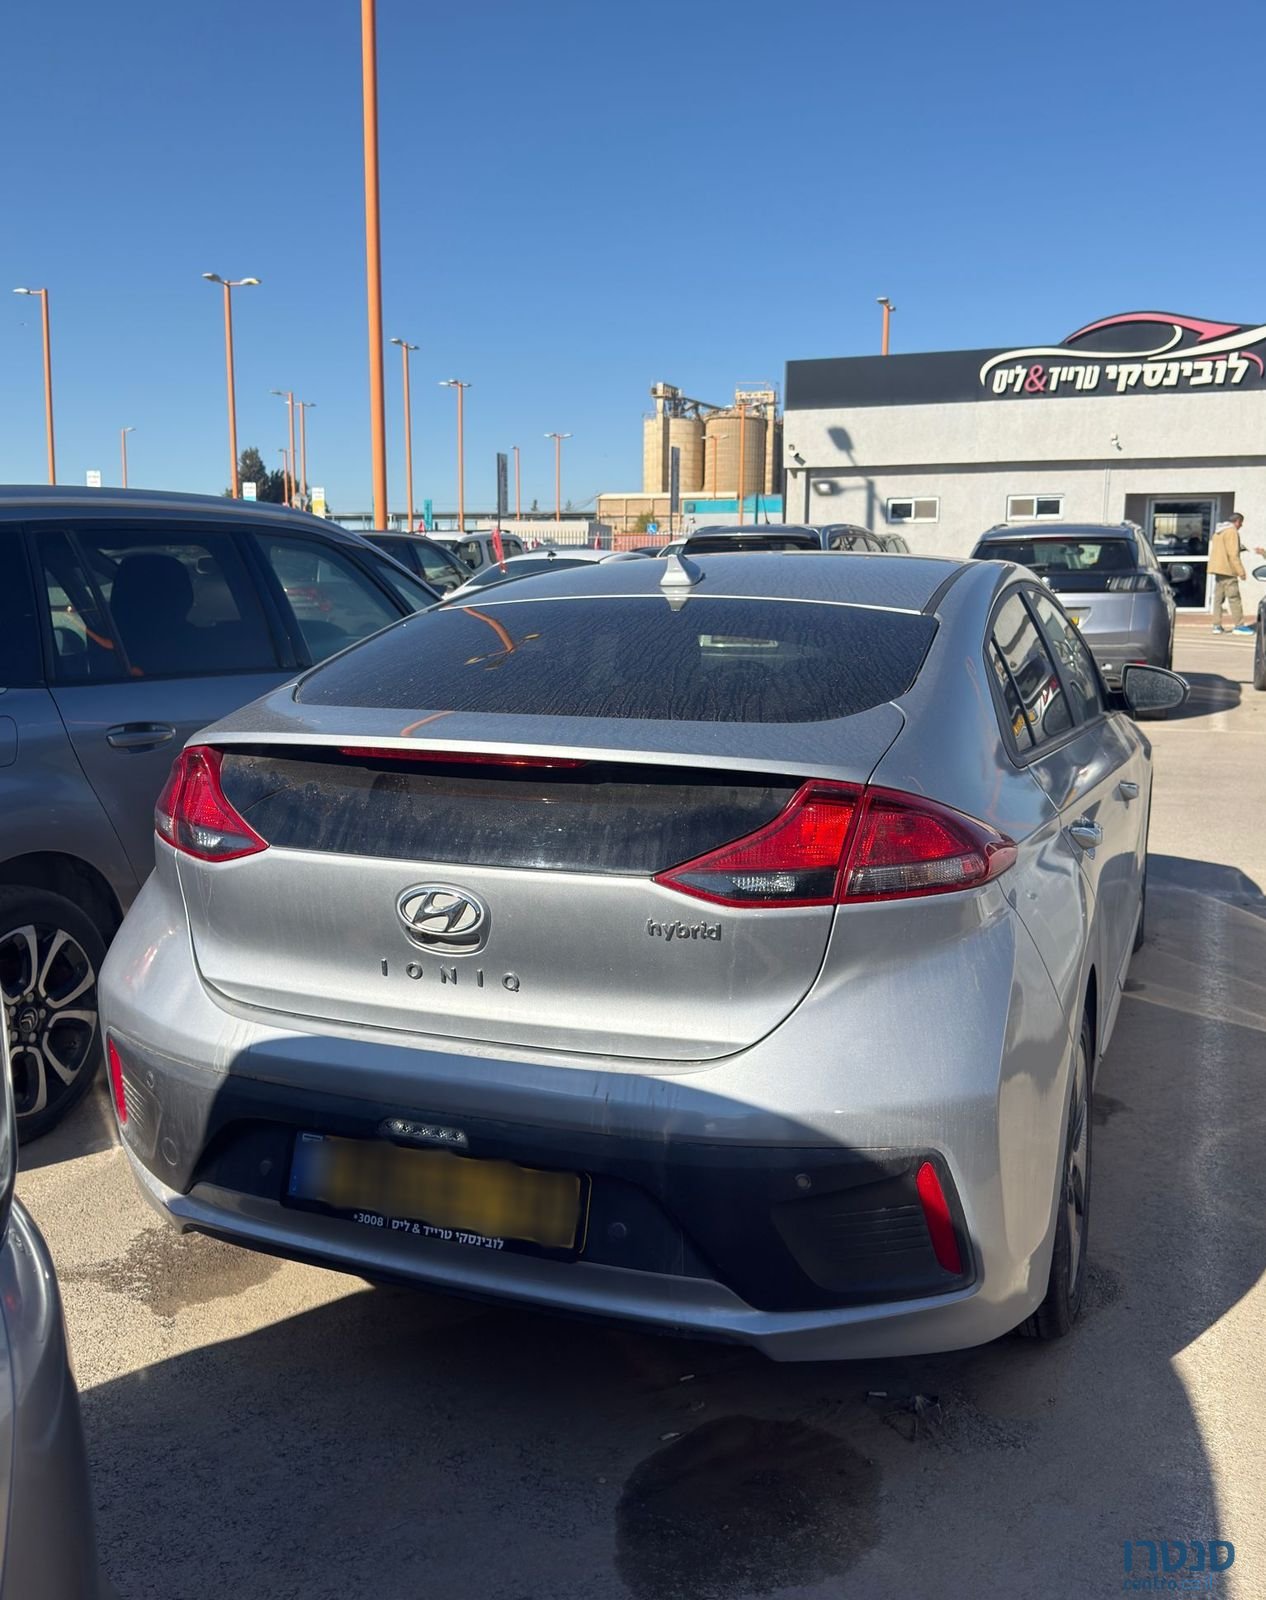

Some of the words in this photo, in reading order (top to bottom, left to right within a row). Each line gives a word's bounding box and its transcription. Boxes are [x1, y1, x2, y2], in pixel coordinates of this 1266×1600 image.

[1105, 352, 1249, 393] לובינסקי
[646, 918, 722, 942] hybrid
[380, 957, 521, 993] IONIQ
[391, 1219, 410, 1232] ליס
[422, 1225, 453, 1240] טרייד
[455, 1231, 504, 1250] לובינסקי
